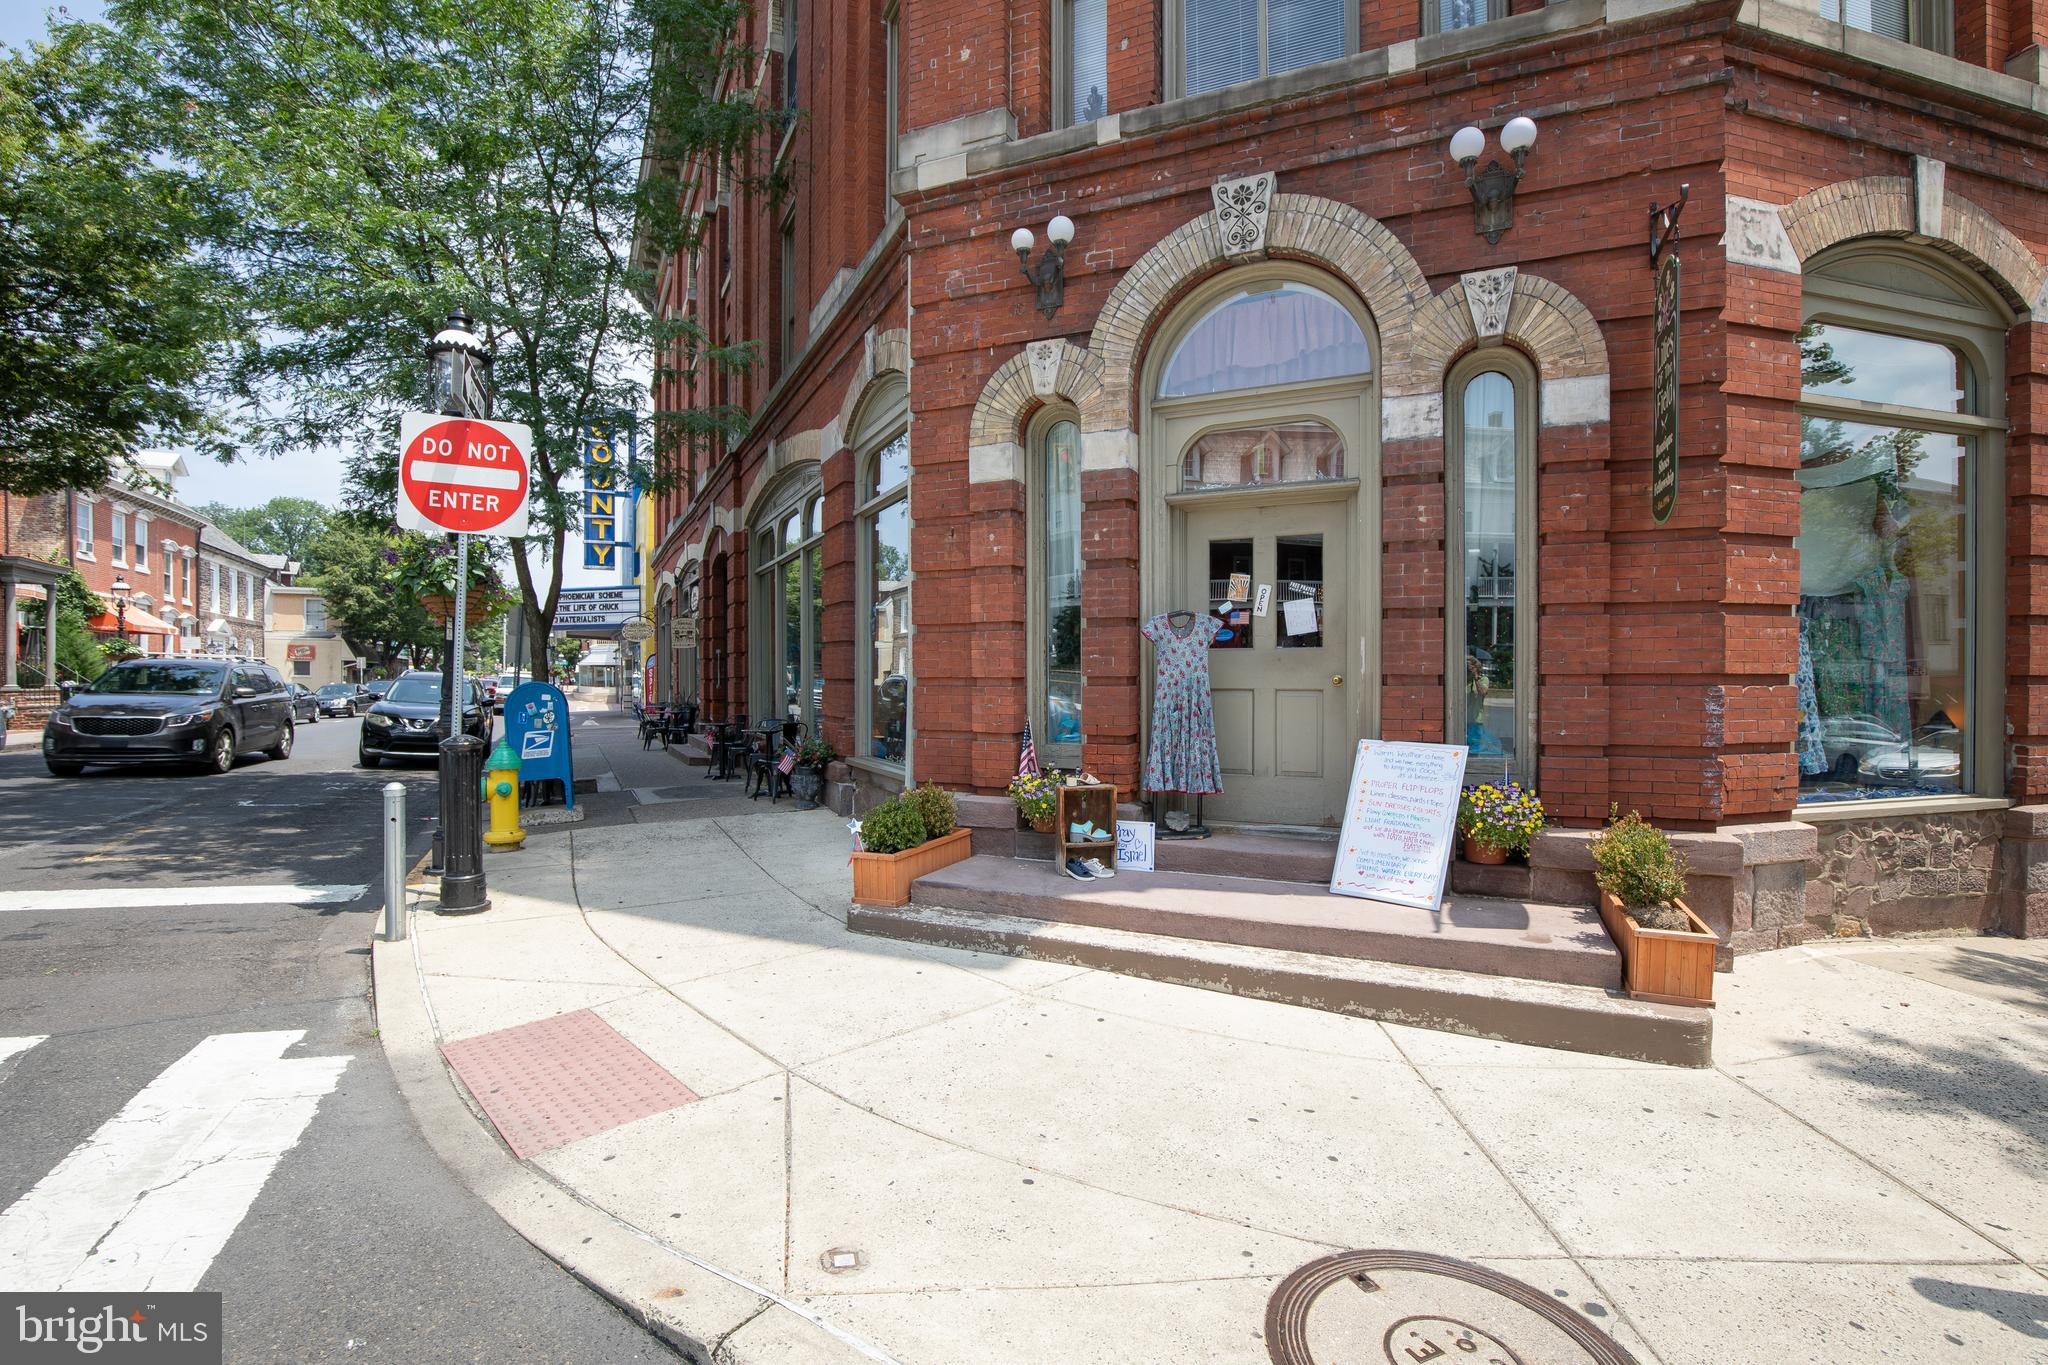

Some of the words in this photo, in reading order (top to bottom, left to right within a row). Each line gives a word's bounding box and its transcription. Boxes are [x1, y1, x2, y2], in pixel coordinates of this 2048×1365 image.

[423, 437, 453, 456] DO
[467, 443, 511, 463] NOT
[428, 489, 500, 513] ENTER
[560, 592, 595, 601] PHOENICIAN
[598, 591, 623, 600] SCHEME
[1256, 588, 1267, 612] OPEN
[559, 604, 571, 612] THE
[573, 604, 586, 612] LIFE
[588, 603, 597, 611] OF
[598, 603, 619, 611] CHUCK
[559, 615, 606, 623] MATERIALISTS
[1401, 783, 1420, 791] FLIP
[1420, 785, 1444, 795] FLOPS
[1116, 844, 1147, 863] Israel
